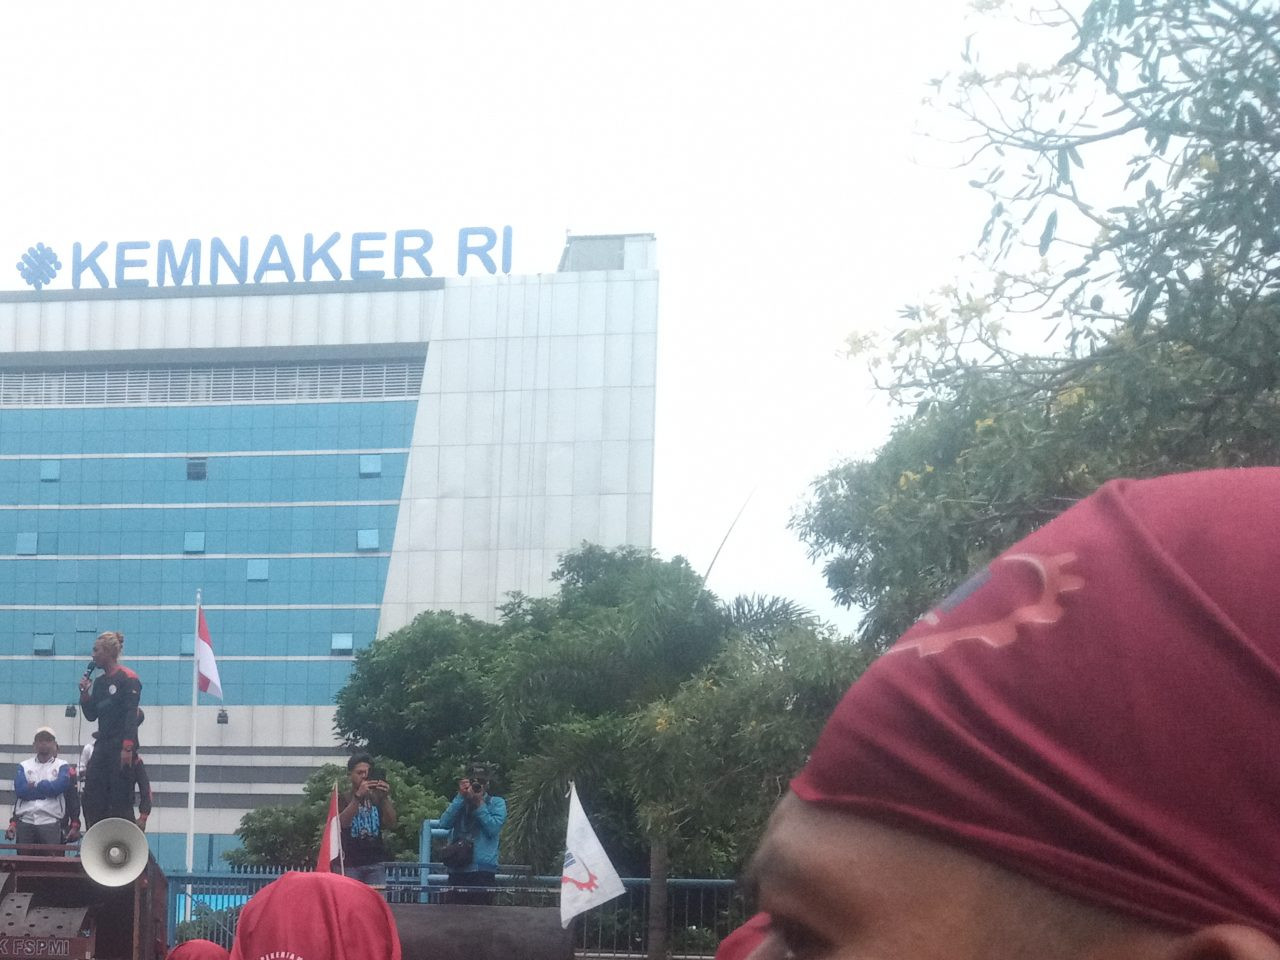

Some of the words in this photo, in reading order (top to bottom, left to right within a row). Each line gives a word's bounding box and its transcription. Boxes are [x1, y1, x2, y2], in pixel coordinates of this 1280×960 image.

[72, 229, 434, 289] KEMNAKER
[457, 224, 514, 277] RI
[13, 939, 70, 956] FSPMI
